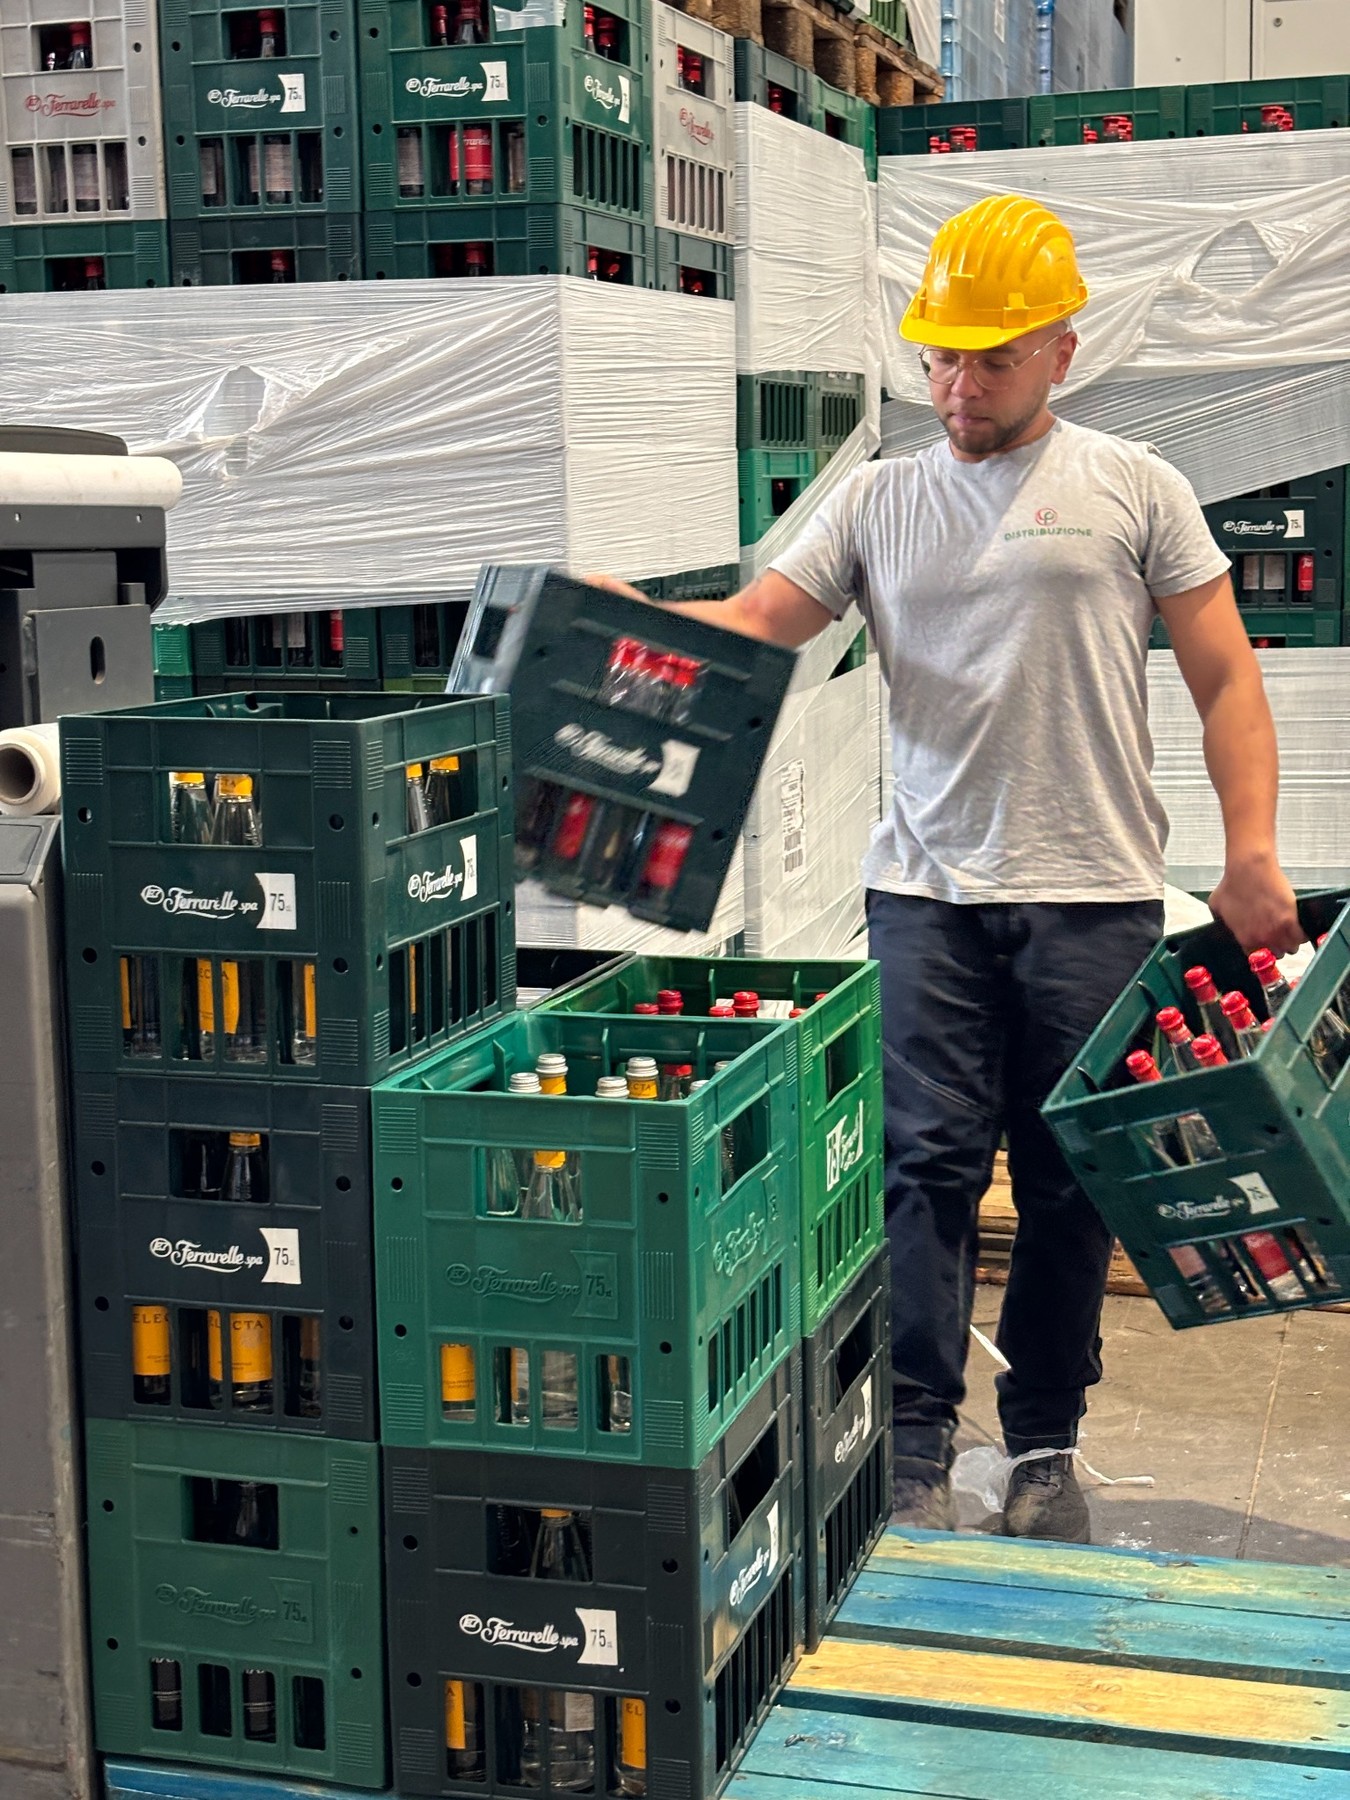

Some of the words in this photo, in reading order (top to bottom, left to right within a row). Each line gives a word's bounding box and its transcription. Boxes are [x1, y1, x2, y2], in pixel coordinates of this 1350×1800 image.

[420, 76, 470, 98] Ferrarelle
[1004, 526, 1093, 541] DISTRIBUZIONE
[163, 887, 238, 919] Ferrarelle
[239, 902, 258, 914] spa
[270, 893, 285, 911] 75
[171, 1240, 244, 1273] Ferrarelle
[244, 1255, 263, 1268] spa
[274, 1248, 288, 1266] 75
[472, 1265, 556, 1303] Ferrarelle
[481, 1617, 559, 1653] Ferrarelle
[559, 1635, 579, 1649] spa
[591, 1629, 606, 1648] 75
